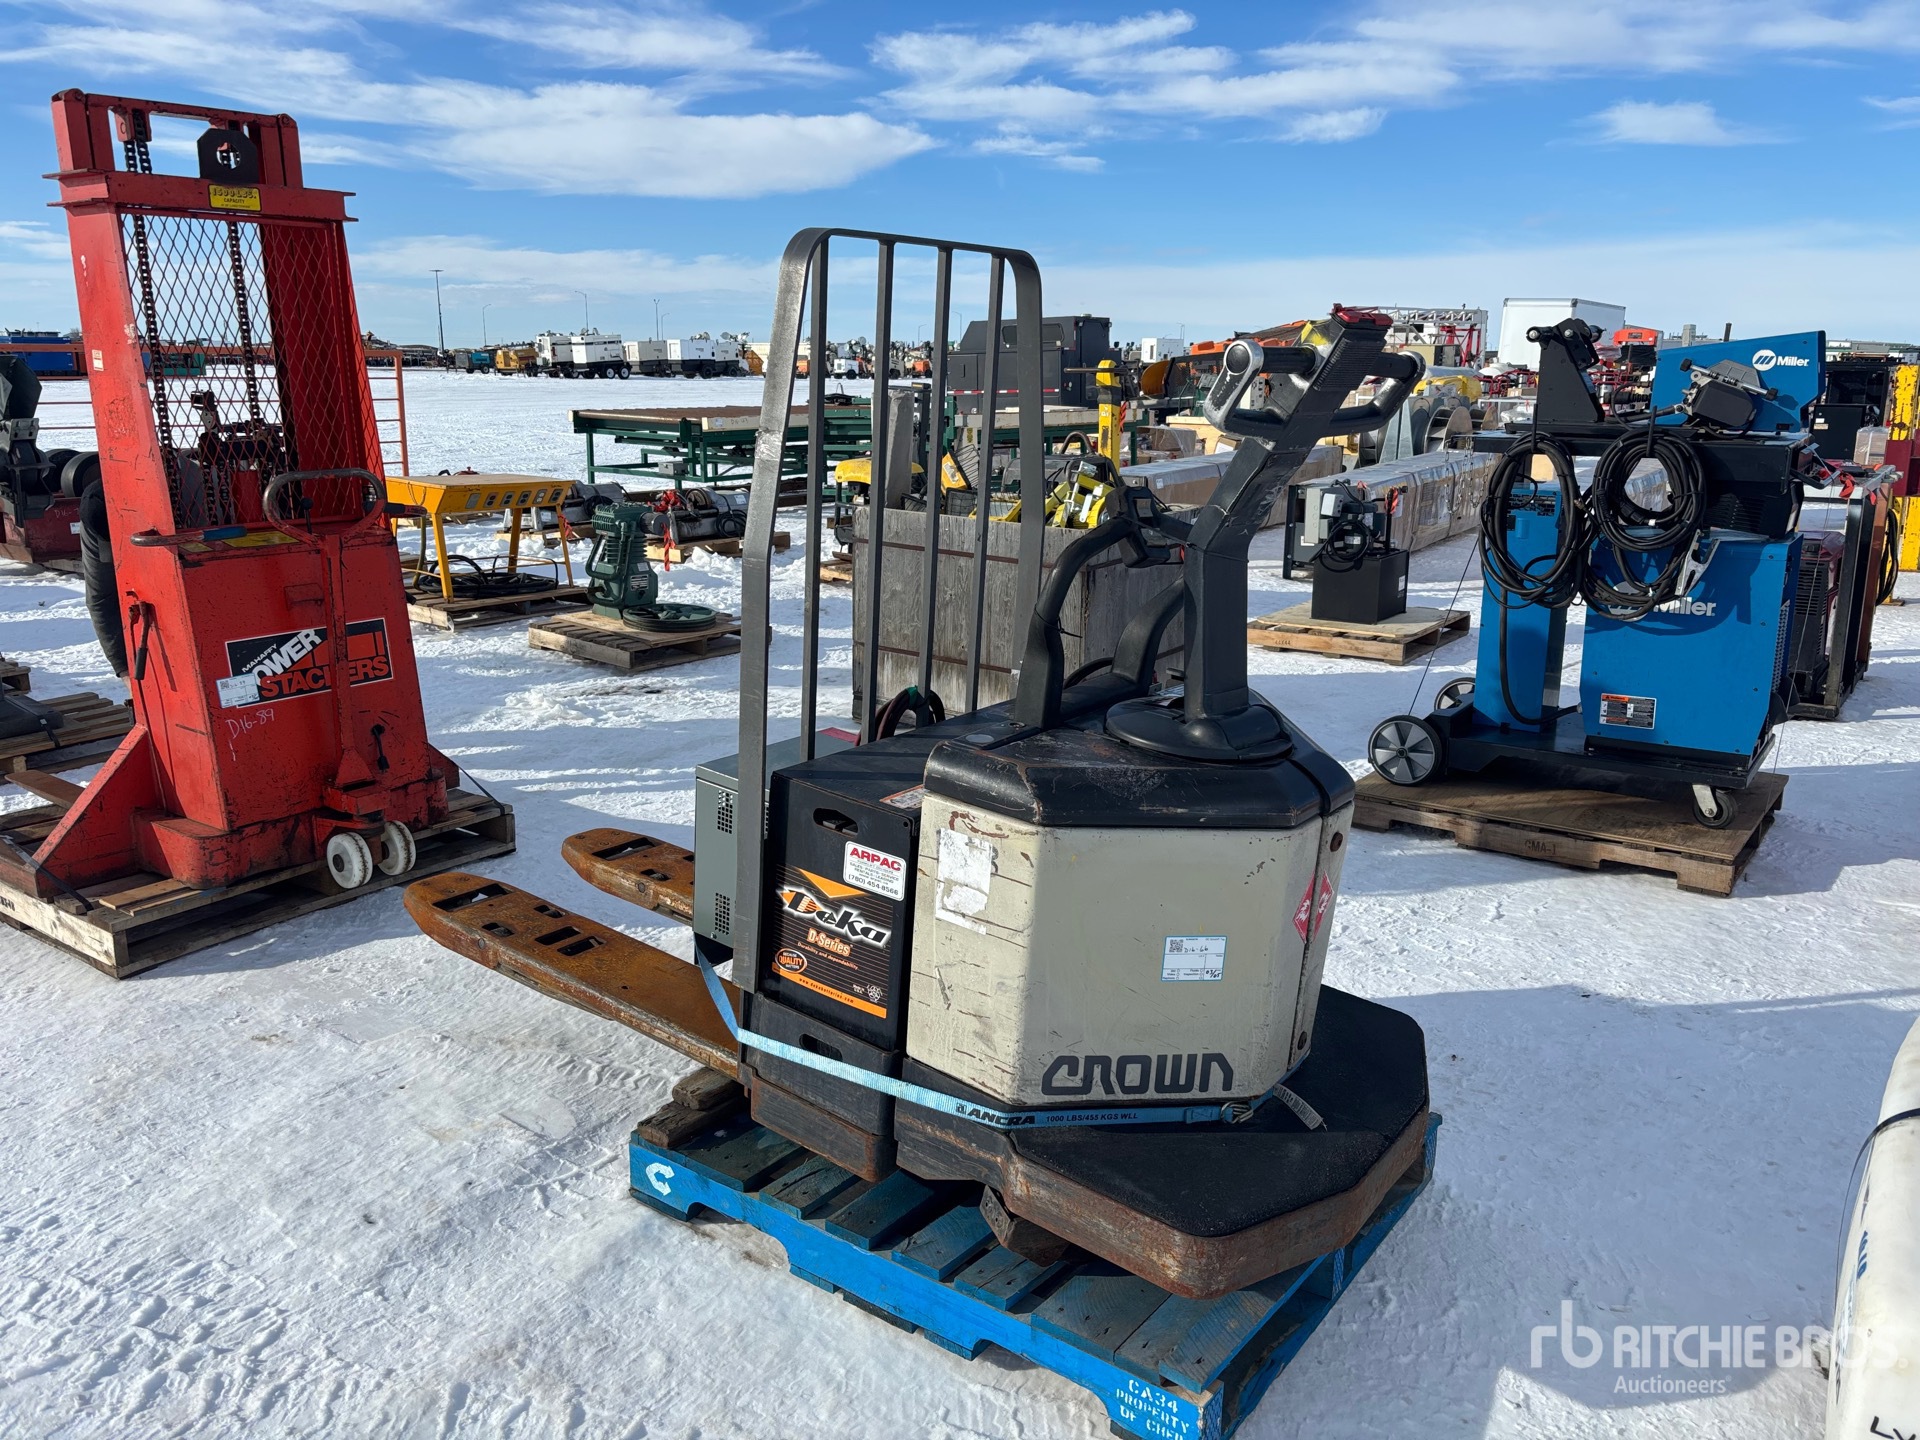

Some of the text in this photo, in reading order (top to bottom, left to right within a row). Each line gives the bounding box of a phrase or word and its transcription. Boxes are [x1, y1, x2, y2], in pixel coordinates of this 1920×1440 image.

[1777, 355, 1810, 367] Miller
[241, 643, 277, 673] MAHAFFY
[252, 629, 322, 686] OWER
[225, 708, 275, 739] D16-89
[850, 847, 902, 872] ARPAC
[778, 888, 888, 945] Deka
[778, 955, 803, 966] QUALITY
[1041, 1052, 1234, 1096] CROWN
[966, 1107, 1138, 1127] ANCRA 1000 LBS/455 KGS WLL
